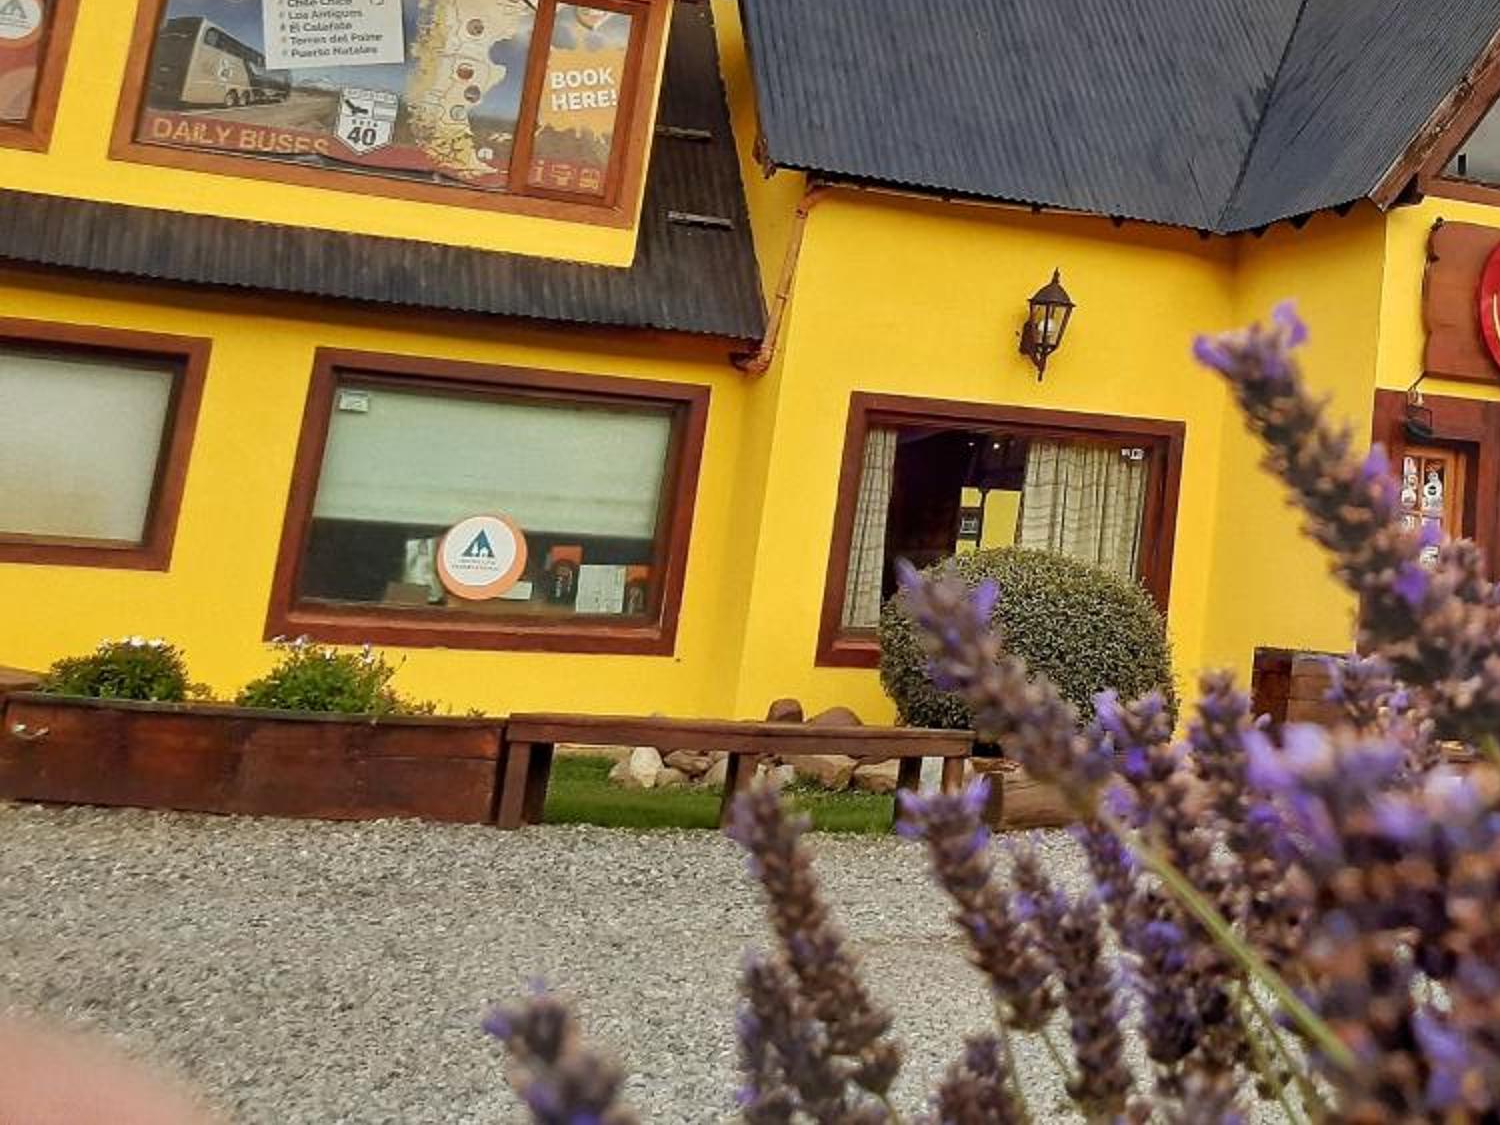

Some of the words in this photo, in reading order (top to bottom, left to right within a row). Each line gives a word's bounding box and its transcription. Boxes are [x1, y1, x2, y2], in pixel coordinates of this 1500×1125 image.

[550, 67, 615, 90] BOOK
[551, 89, 618, 112] HERE!
[346, 127, 377, 147] 40
